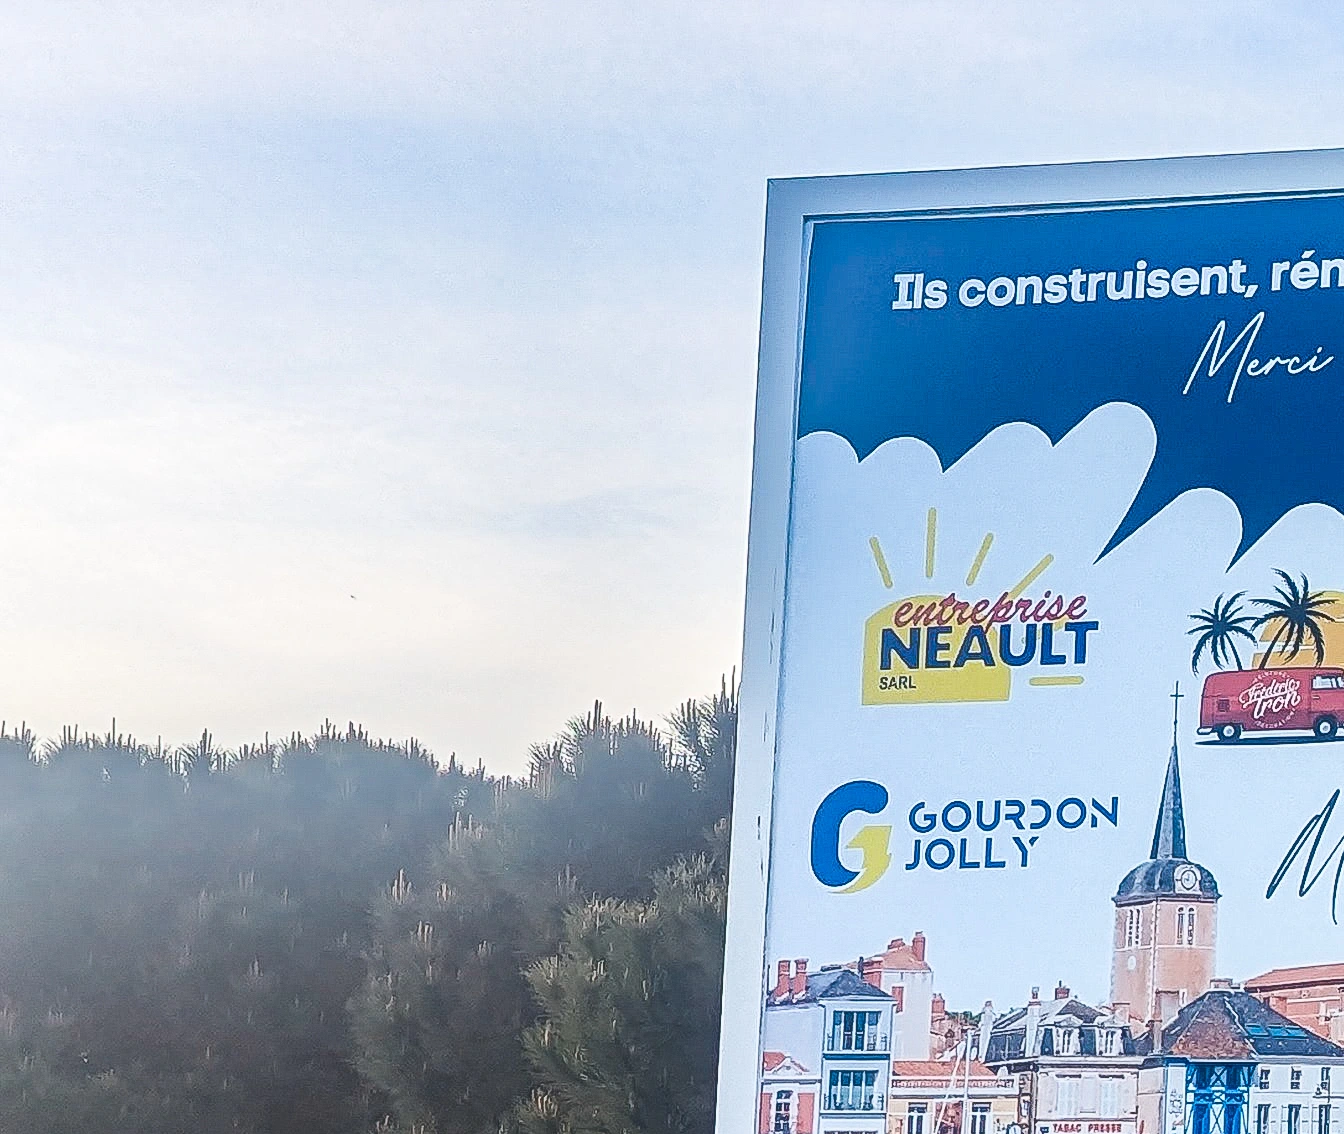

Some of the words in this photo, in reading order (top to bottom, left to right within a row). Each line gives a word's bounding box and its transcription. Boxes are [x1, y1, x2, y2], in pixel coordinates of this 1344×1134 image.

[892, 272, 948, 311] Ils
[958, 258, 1259, 308] construisent,
[1182, 311, 1335, 404] Merci
[895, 590, 1089, 634] entreprise
[879, 620, 1100, 671] NEAULT
[878, 676, 918, 691] SARL
[908, 796, 1119, 834] GOURDON
[904, 835, 1040, 871] JOLLY
